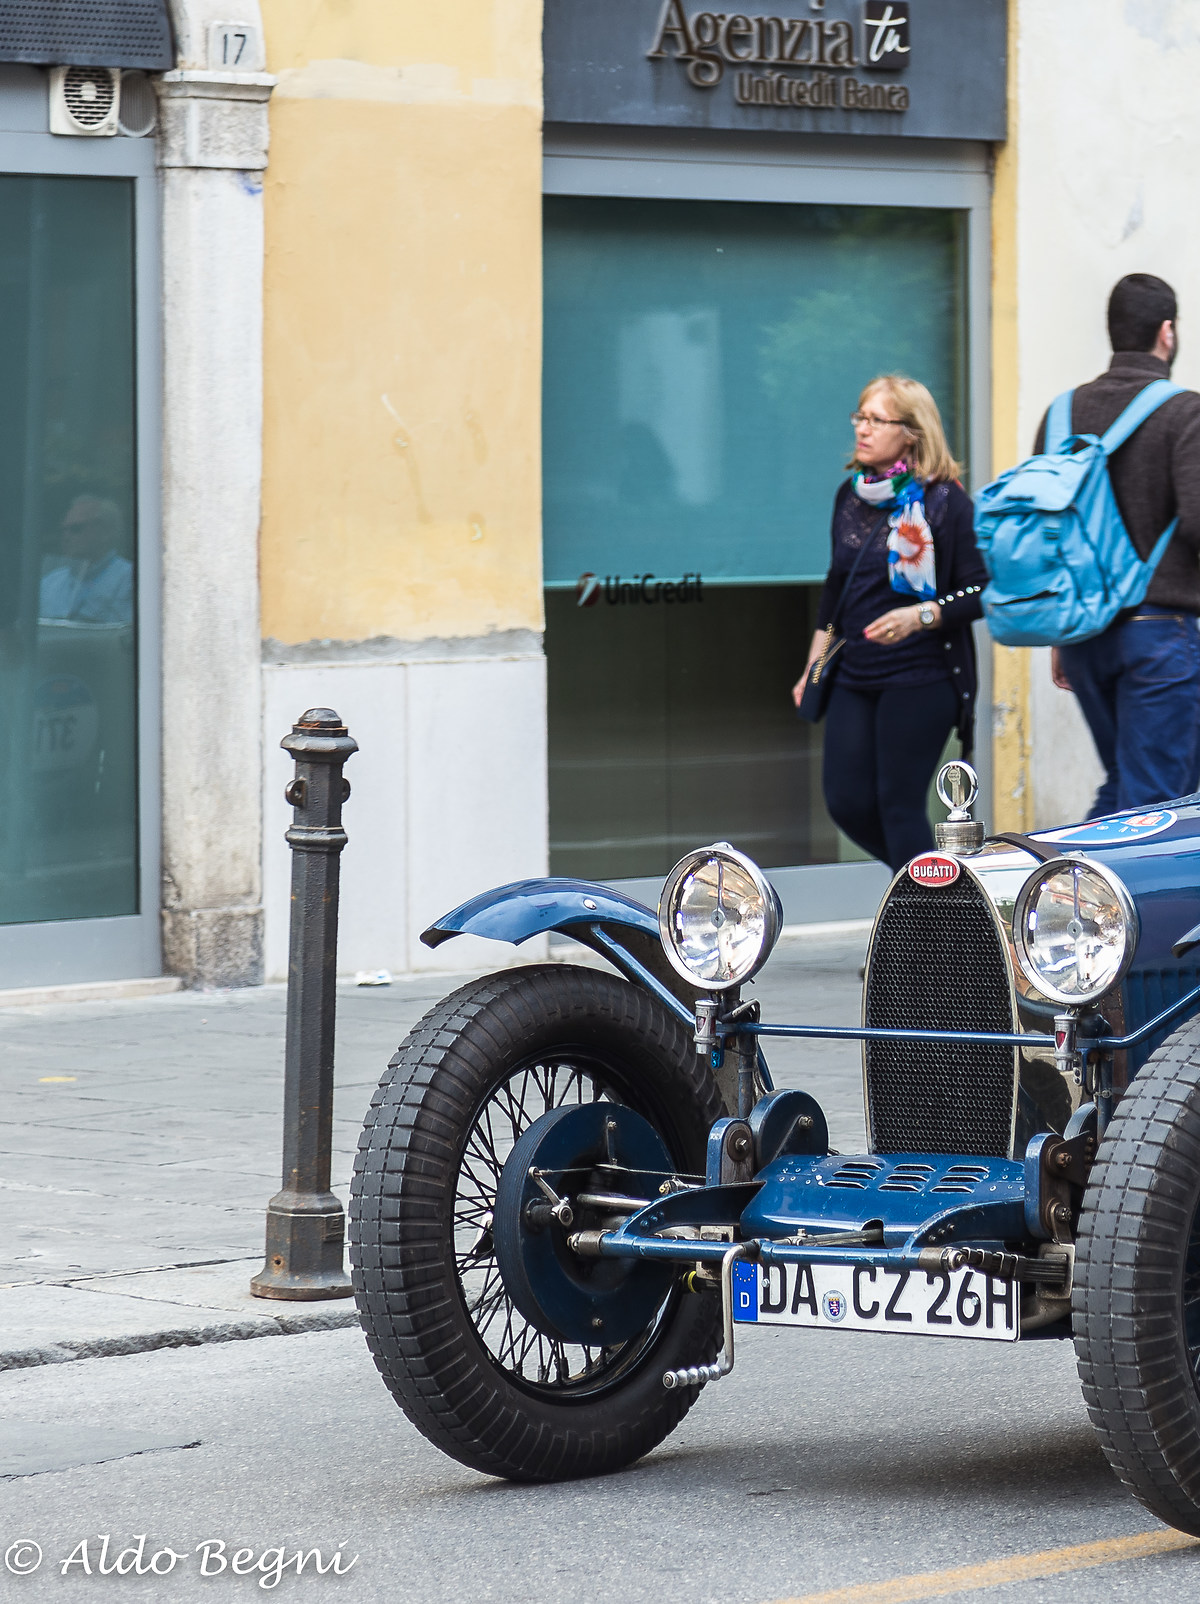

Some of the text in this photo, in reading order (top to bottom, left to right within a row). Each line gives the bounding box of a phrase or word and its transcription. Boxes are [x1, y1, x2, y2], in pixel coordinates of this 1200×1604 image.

[223, 33, 247, 65] 17
[645, 0, 859, 87] Agenzia
[734, 69, 911, 112] UniCredit Banca
[604, 571, 704, 606] UniCredit
[913, 865, 954, 878] BUGATTI
[740, 1292, 750, 1308] D
[759, 1262, 1014, 1331] DA CZ 26H
